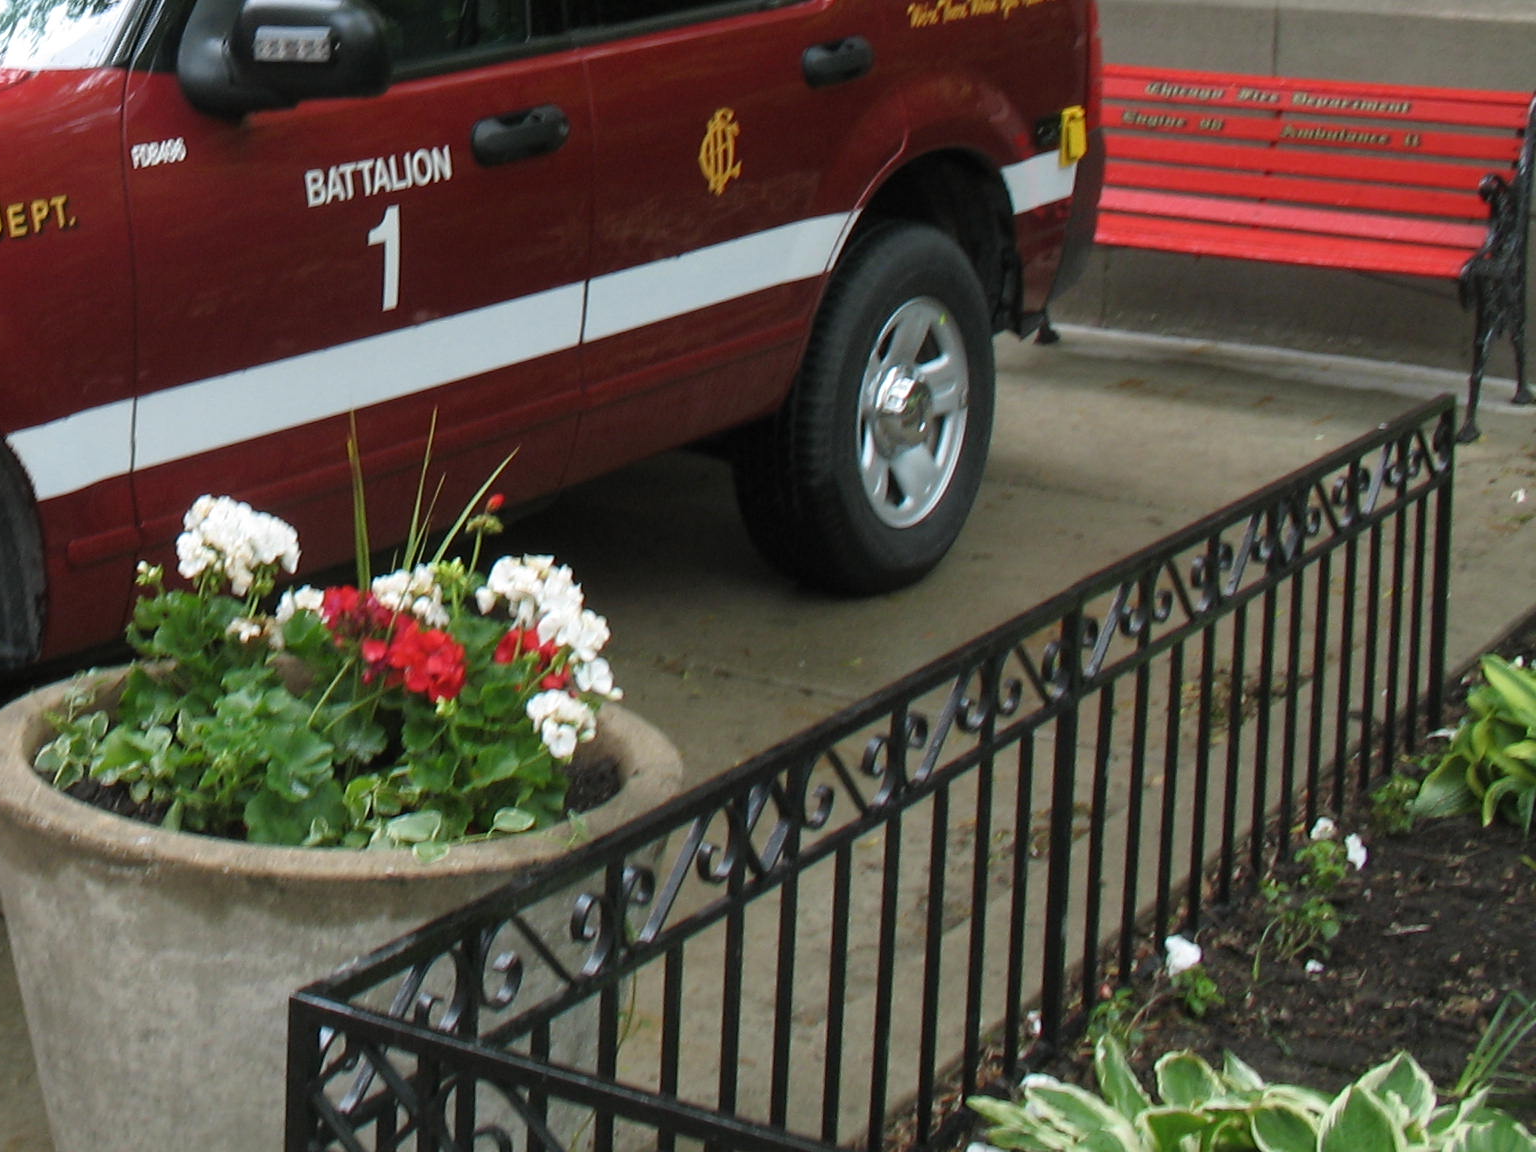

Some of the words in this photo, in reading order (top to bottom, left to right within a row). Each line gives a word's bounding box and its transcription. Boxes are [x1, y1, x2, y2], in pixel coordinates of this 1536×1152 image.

[1122, 111, 1187, 128] Engine
[1292, 91, 1412, 114] Department
[304, 144, 454, 208] BATTALION
[367, 204, 402, 312] 1
